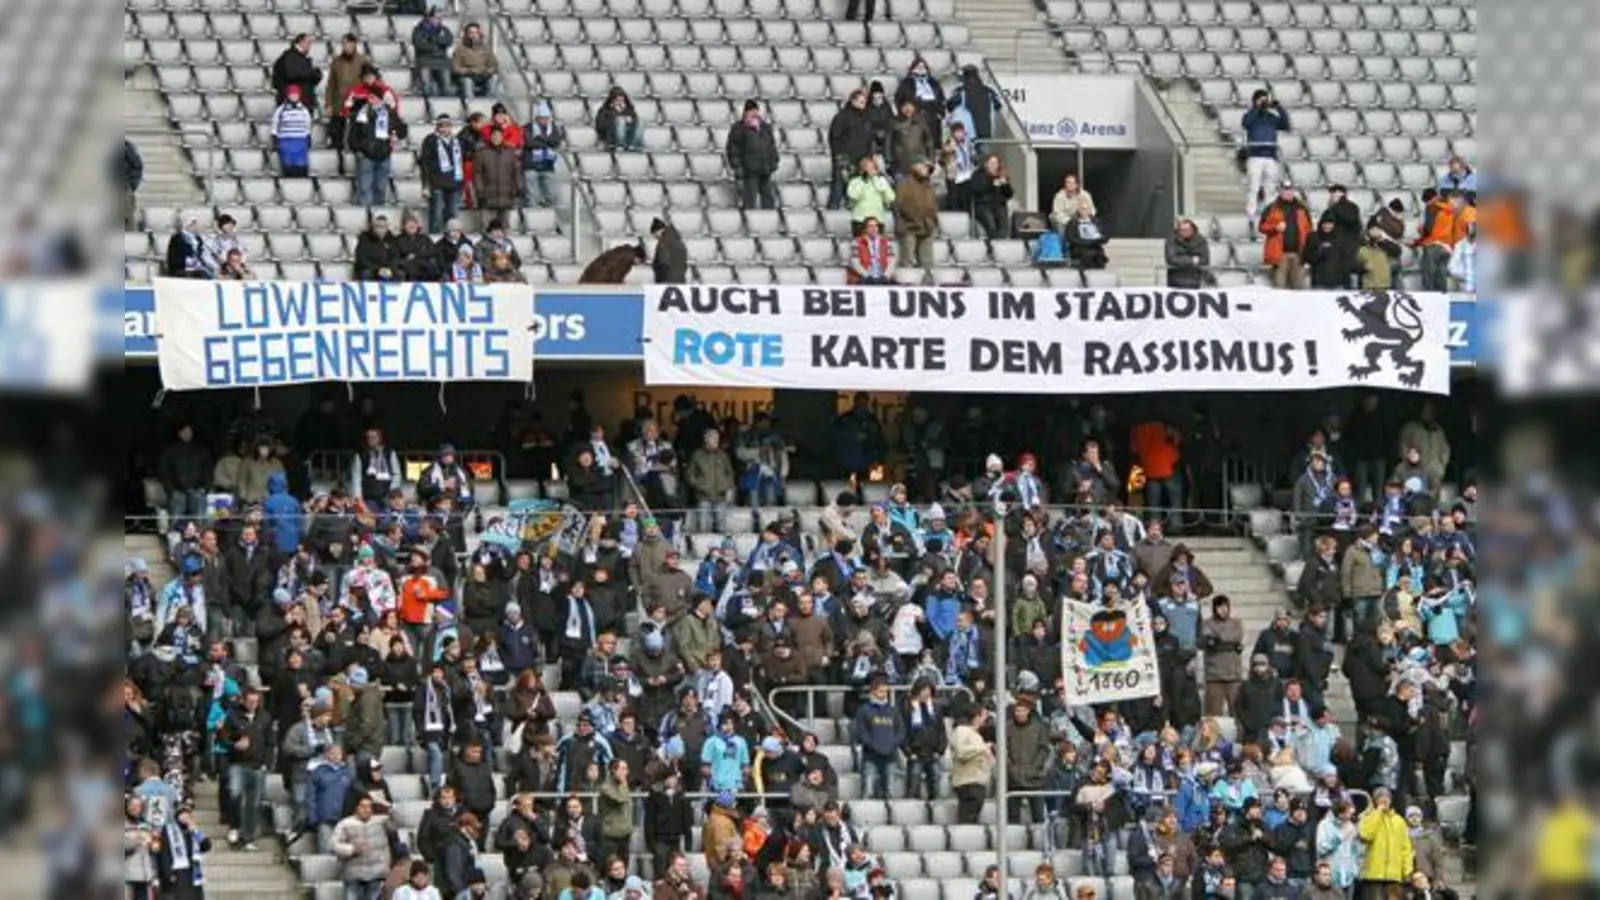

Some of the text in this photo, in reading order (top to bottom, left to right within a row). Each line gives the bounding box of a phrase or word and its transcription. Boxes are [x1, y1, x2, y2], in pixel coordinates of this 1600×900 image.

[1080, 122, 1126, 136] Arena
[658, 286, 781, 315] AUCH
[803, 289, 866, 317] BEI
[890, 290, 967, 318] UNS
[988, 291, 1036, 320] IM
[672, 328, 784, 367] ROTE
[811, 335, 946, 371] KARTE
[970, 338, 1062, 375] DEM
[1089, 670, 1140, 691] 1860
